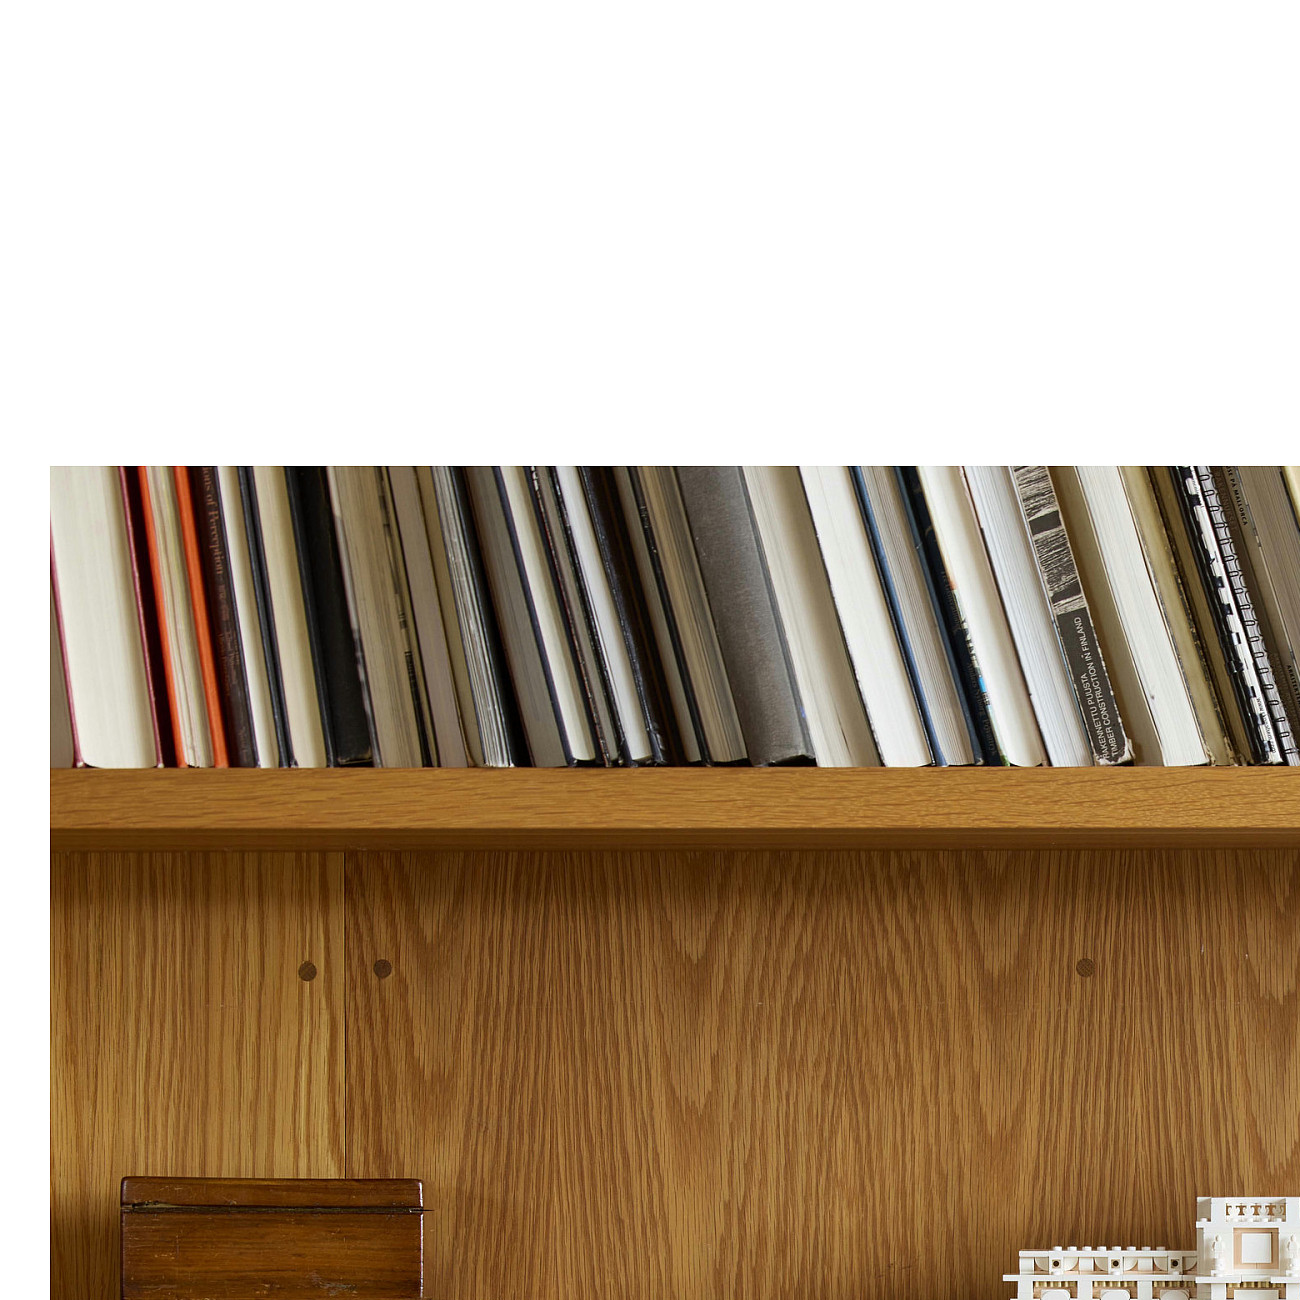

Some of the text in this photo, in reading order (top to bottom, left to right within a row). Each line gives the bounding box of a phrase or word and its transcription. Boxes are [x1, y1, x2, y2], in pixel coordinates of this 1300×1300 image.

[1230, 478, 1237, 488] PÅ
[1234, 489, 1248, 526] MALLORCA
[204, 510, 227, 575] Perception
[1074, 617, 1119, 756] TIMBER CONSTRUCTION IN FINLAND
[1081, 673, 1110, 758] RAKENNETTU PUUSTA
